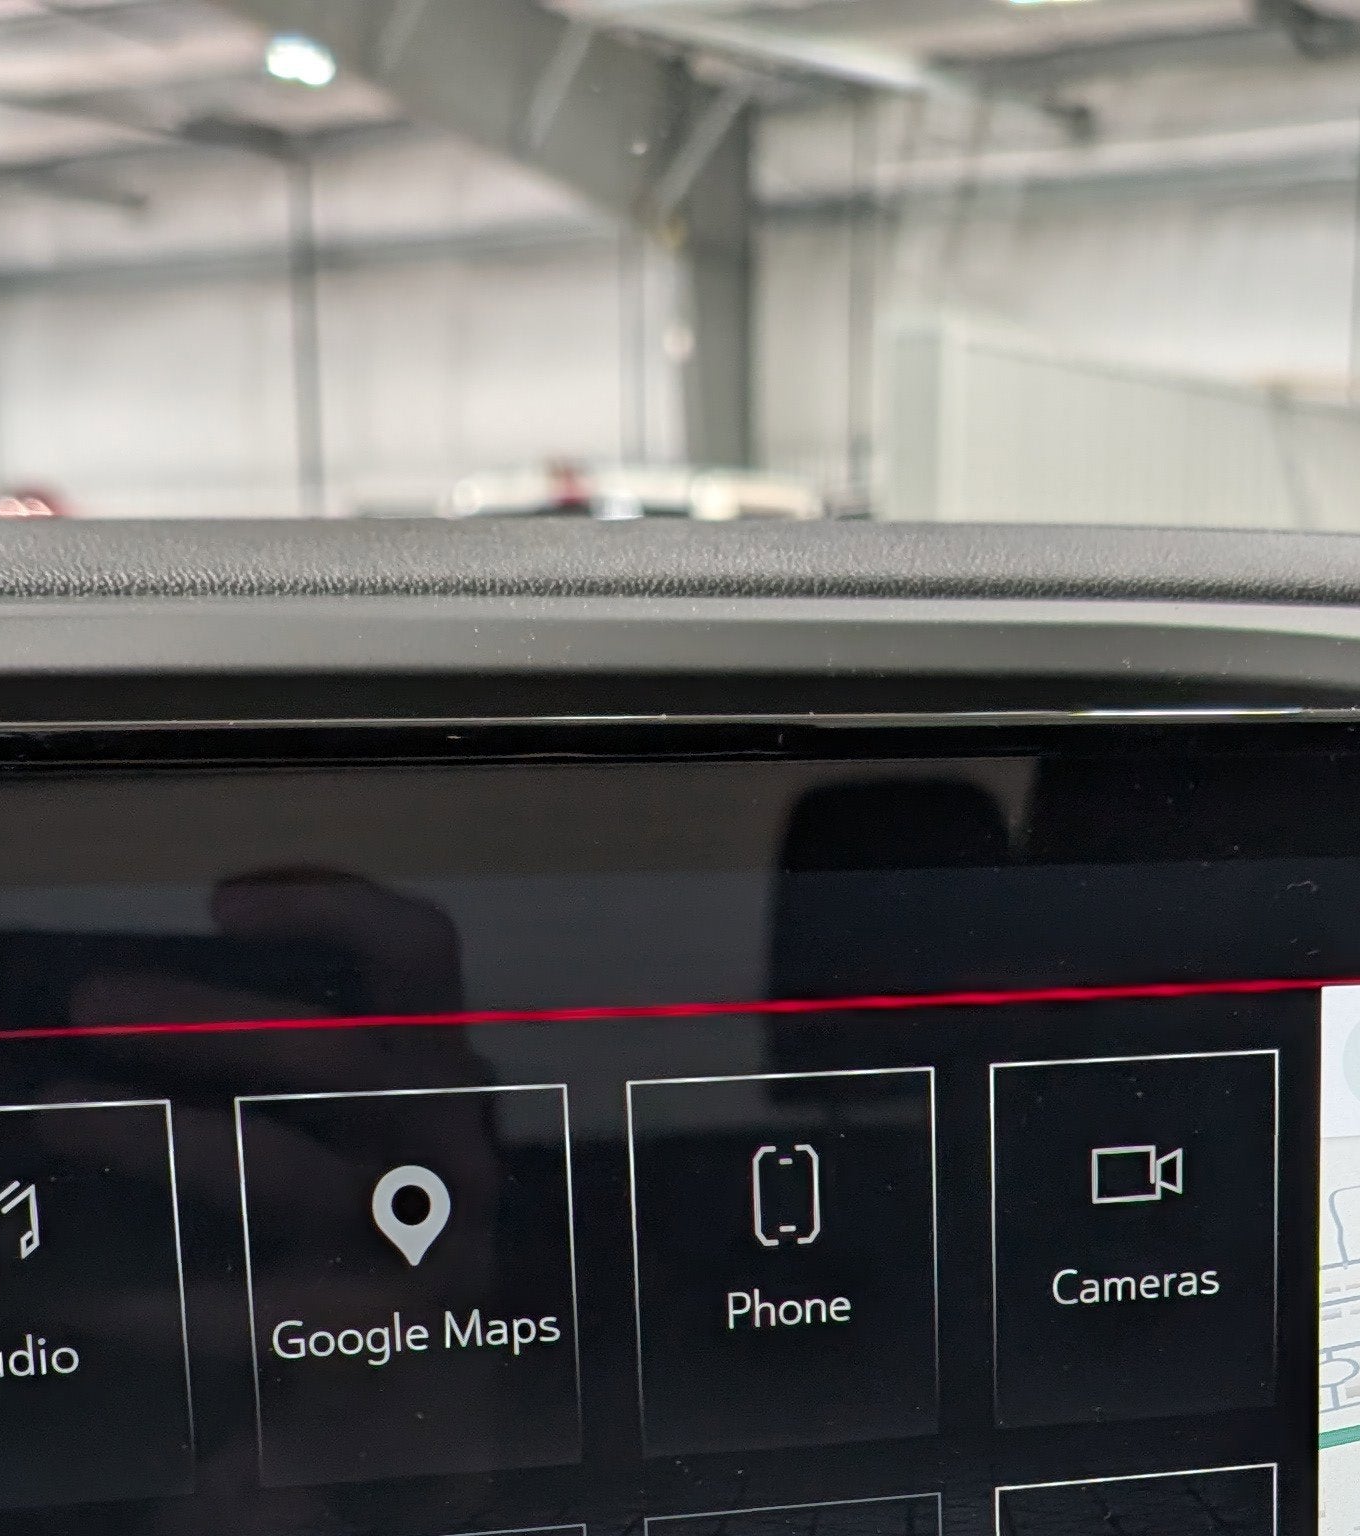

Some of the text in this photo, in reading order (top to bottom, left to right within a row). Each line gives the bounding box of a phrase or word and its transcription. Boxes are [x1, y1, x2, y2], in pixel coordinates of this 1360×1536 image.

[1051, 1267, 1221, 1306] Cameras
[727, 1288, 852, 1330] Phone
[271, 1307, 562, 1367] Google Maps
